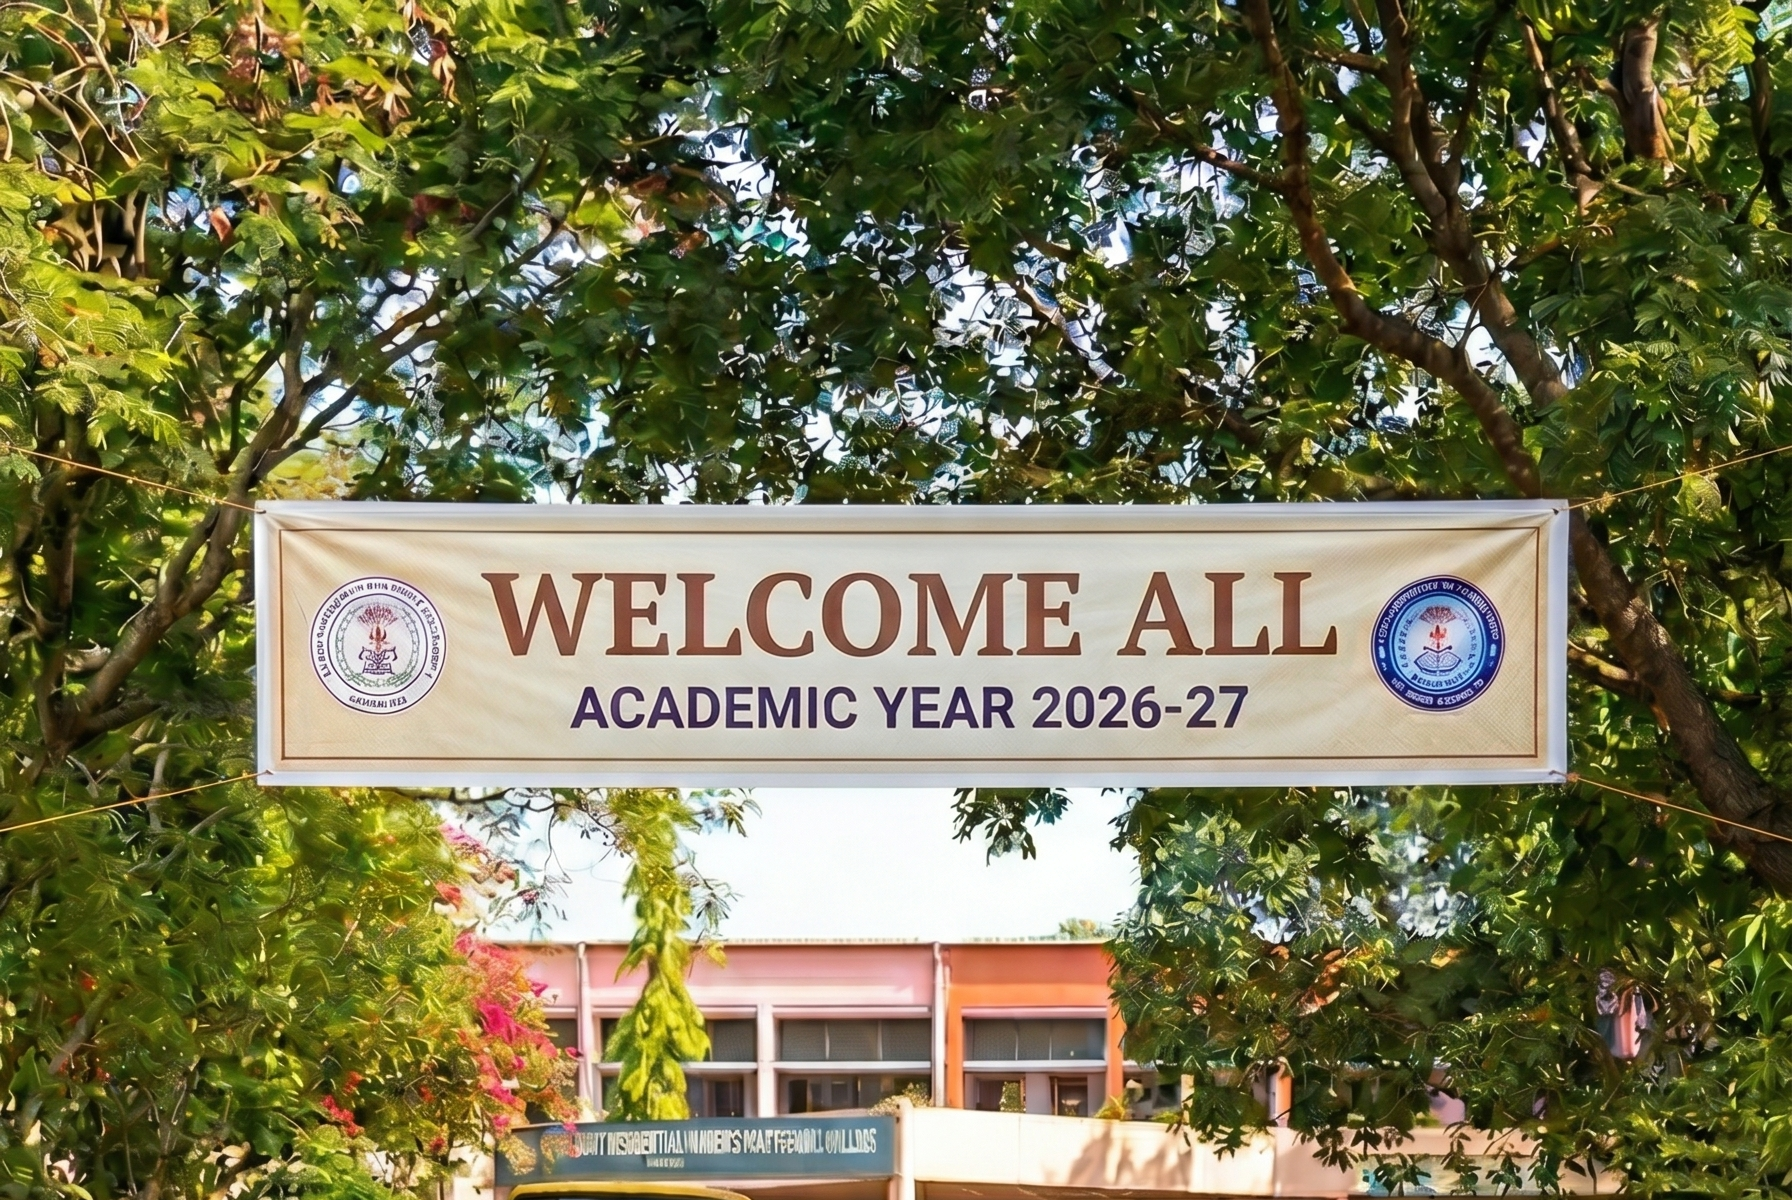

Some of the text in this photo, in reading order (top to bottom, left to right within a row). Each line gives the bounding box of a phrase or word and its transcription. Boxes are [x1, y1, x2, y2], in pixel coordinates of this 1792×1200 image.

[480, 571, 1082, 658] WELCOME
[1116, 571, 1338, 657] ALL
[570, 685, 1249, 730] ACADEMIC YEAR 2026-27
